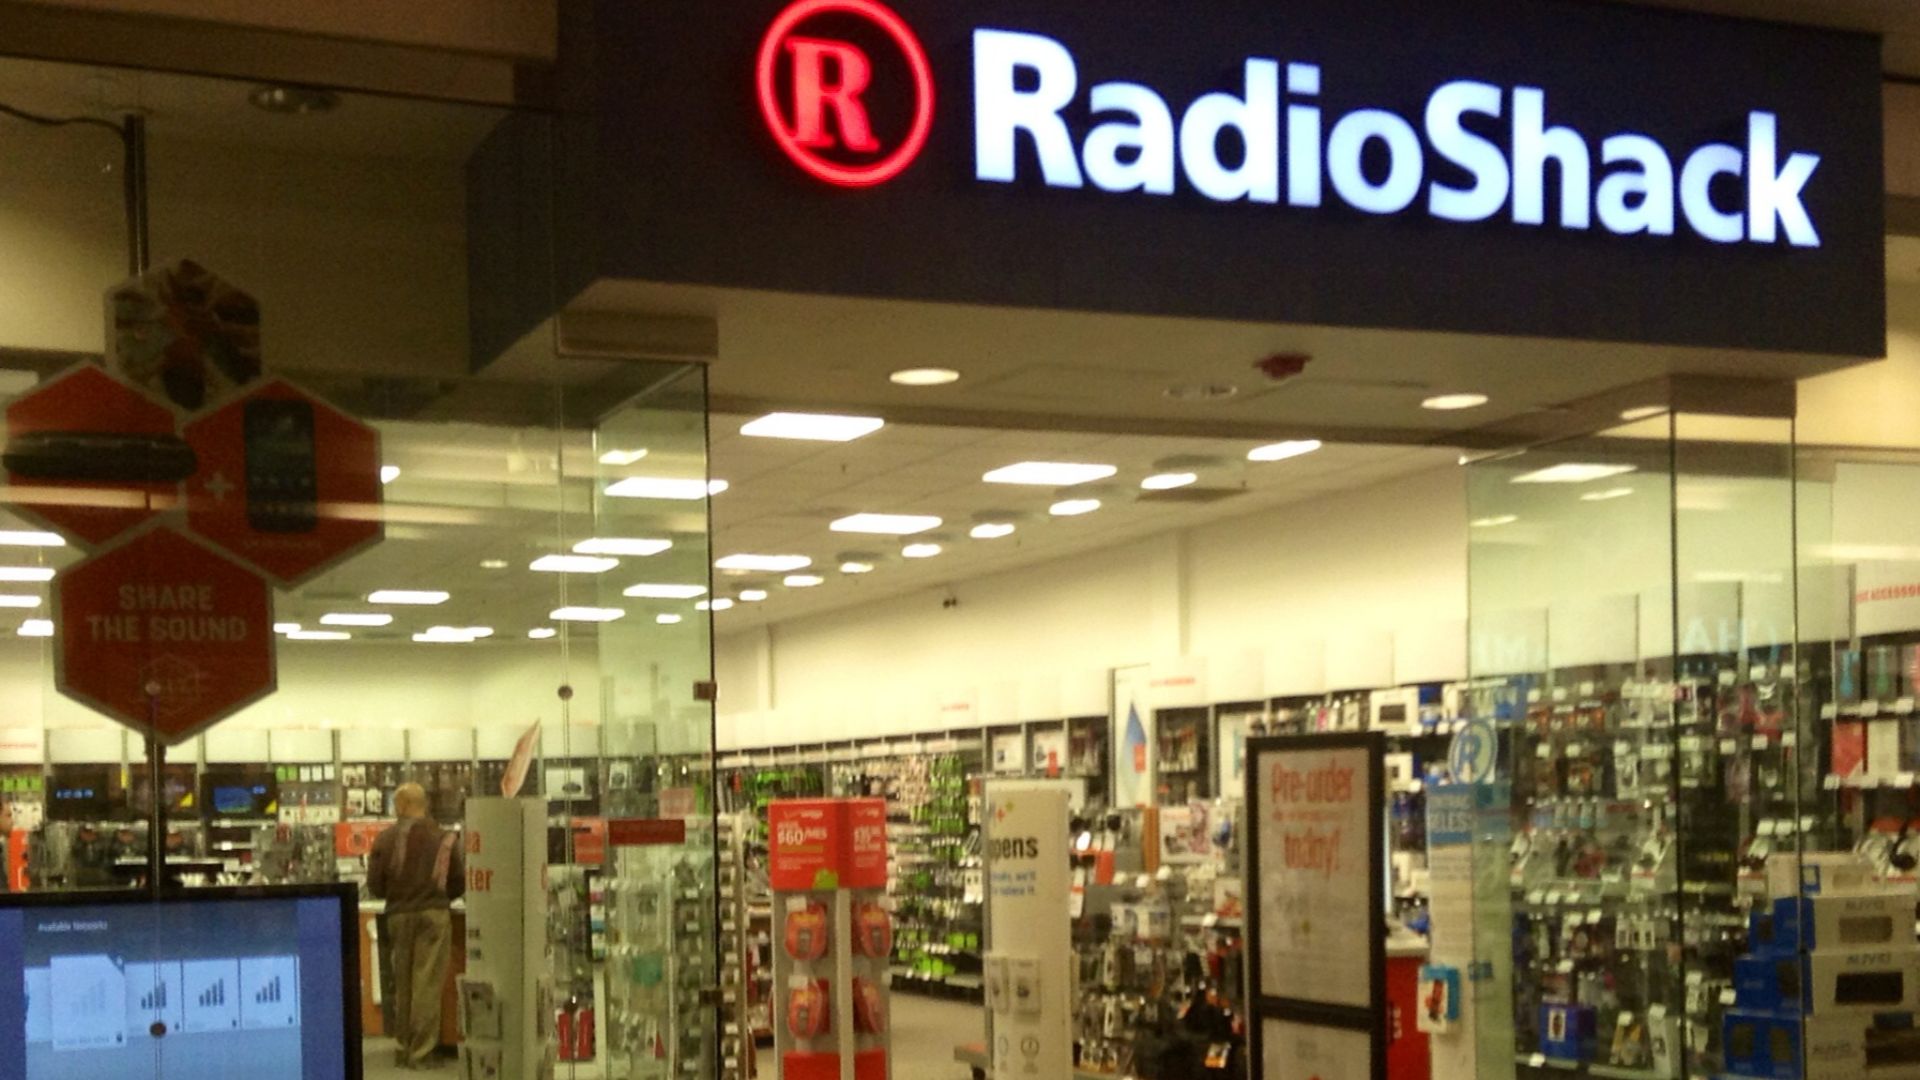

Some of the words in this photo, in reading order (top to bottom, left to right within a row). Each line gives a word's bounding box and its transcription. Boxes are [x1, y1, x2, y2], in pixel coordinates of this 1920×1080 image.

[973, 27, 1821, 248] RadioShack
[118, 583, 215, 612] SHARE
[86, 614, 140, 643] THE
[151, 615, 248, 643] SOUND
